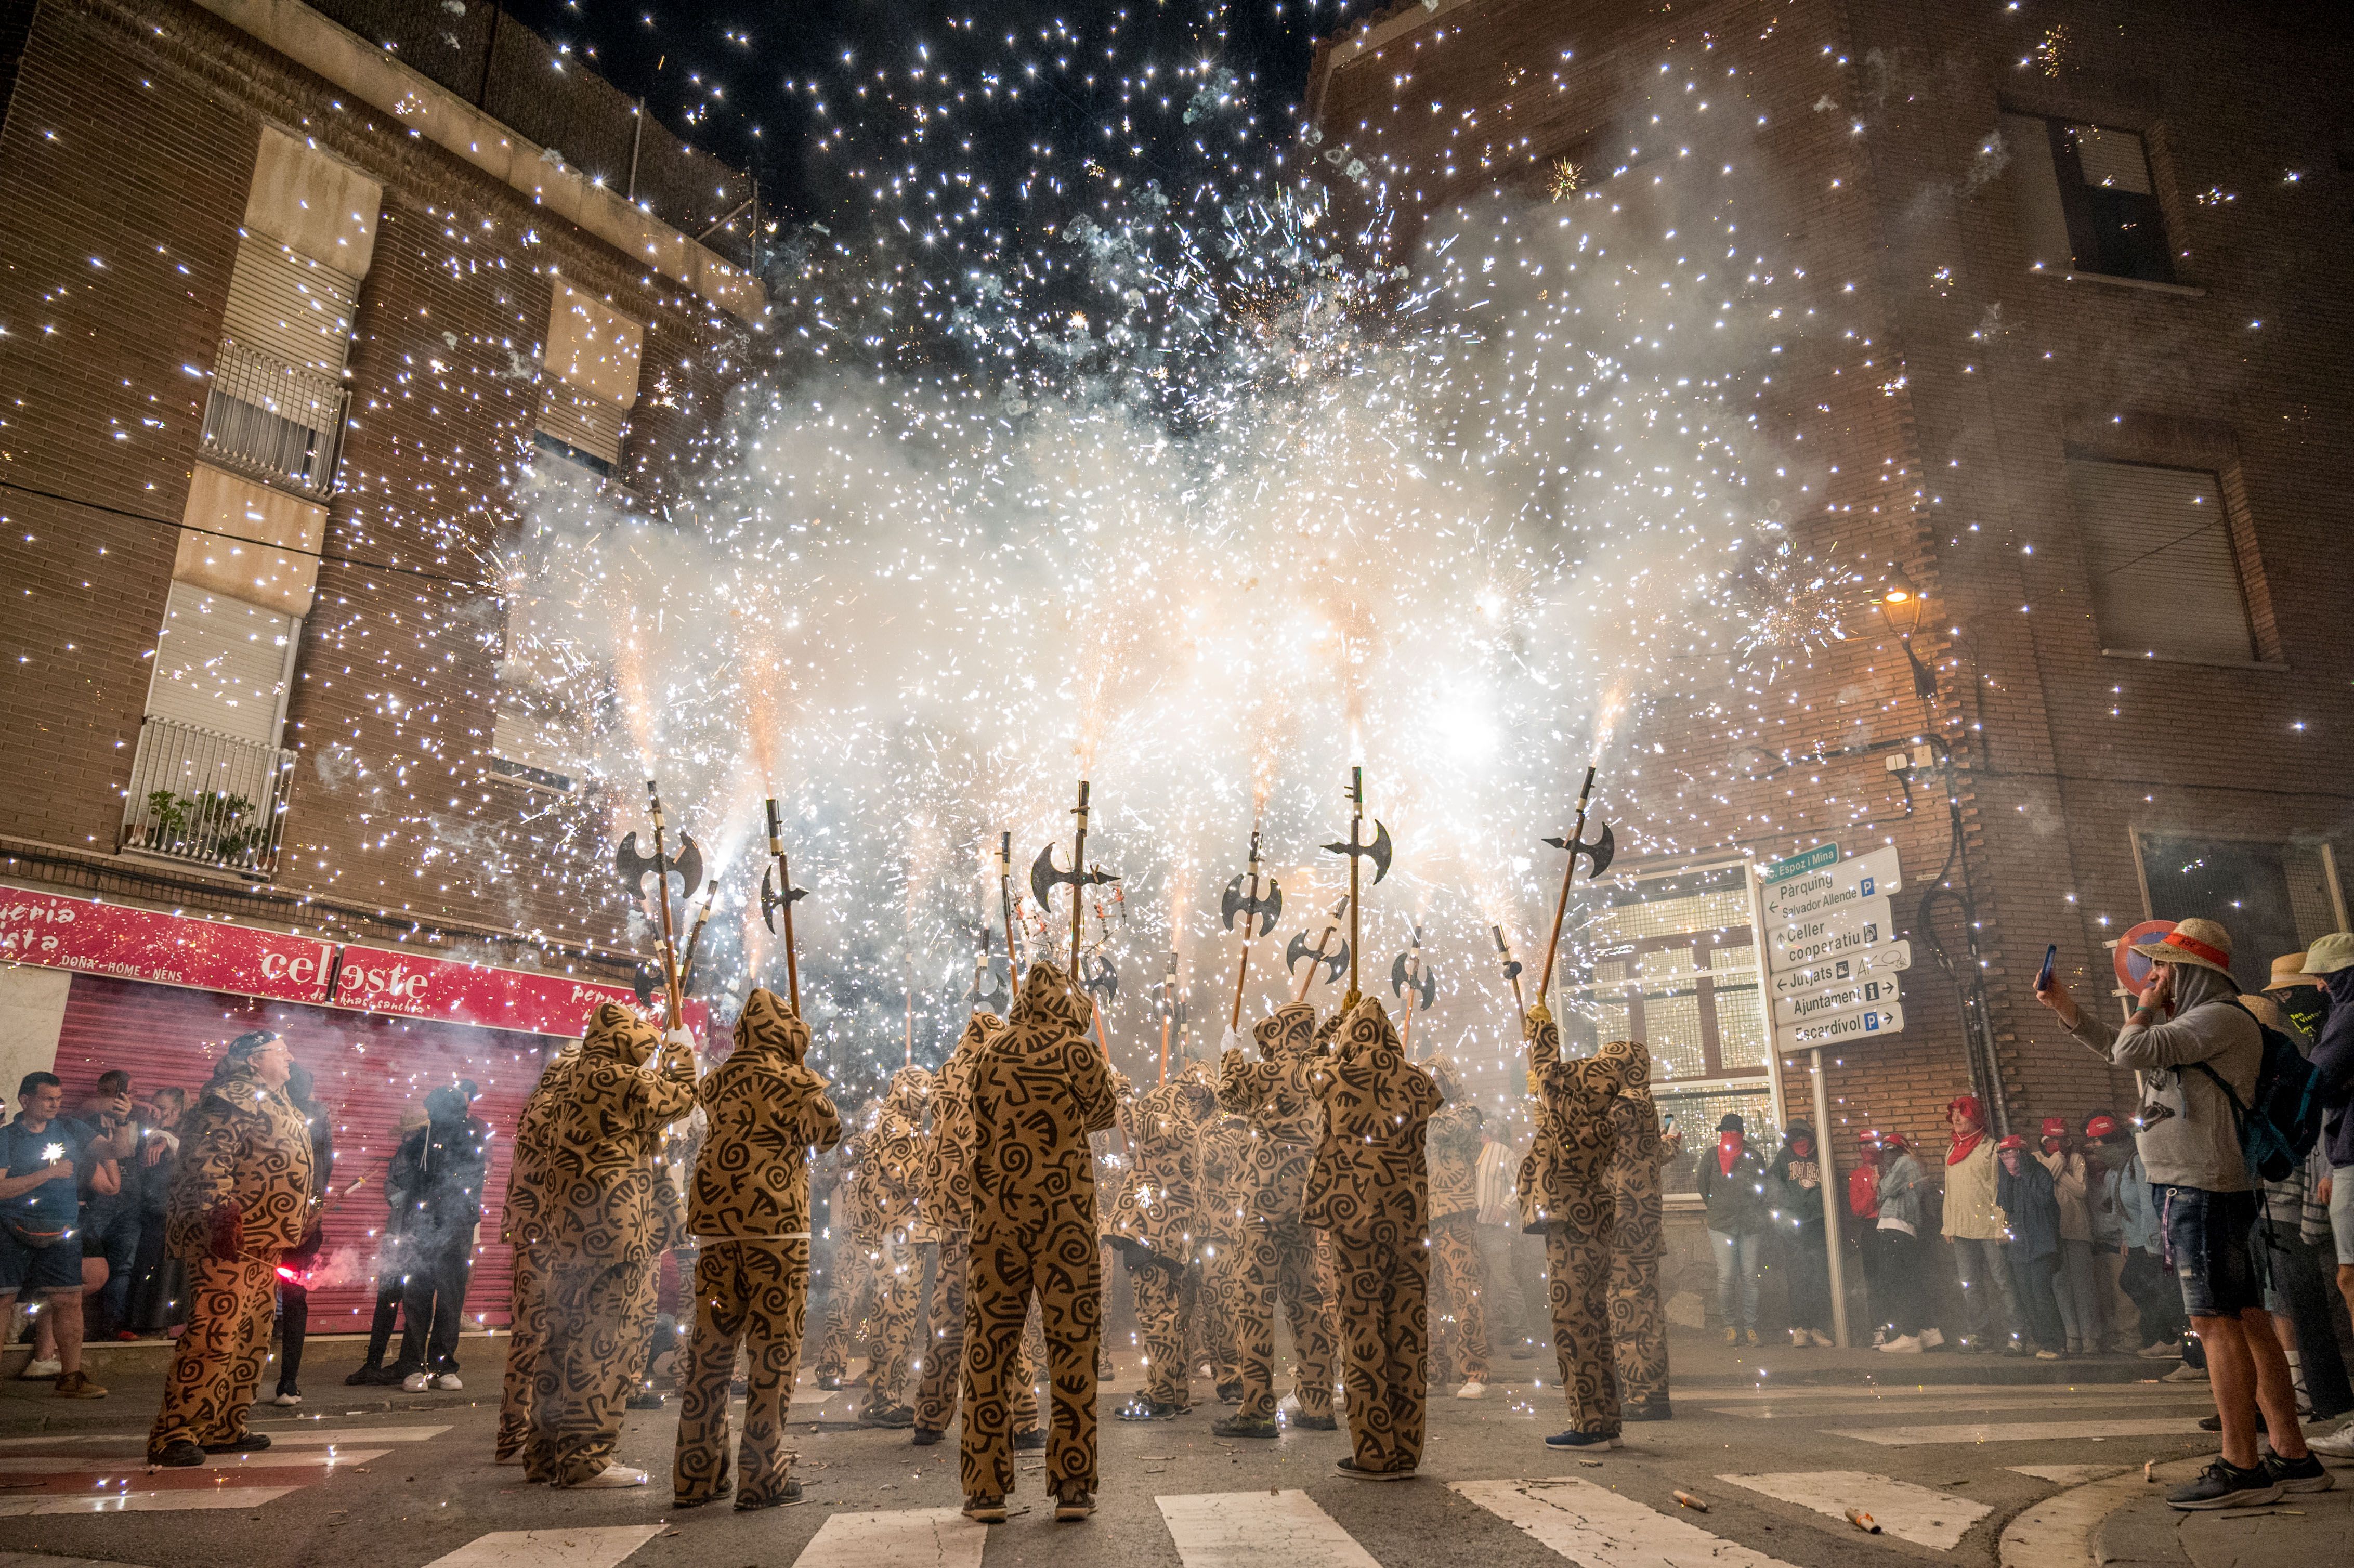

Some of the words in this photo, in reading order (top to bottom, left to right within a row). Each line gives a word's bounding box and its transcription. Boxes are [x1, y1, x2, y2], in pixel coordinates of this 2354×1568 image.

[1779, 860, 1806, 877] Espoz
[1807, 857, 1812, 866] i
[1812, 851, 1834, 864] Mina
[1780, 874, 1833, 900] Pàrquing
[1782, 899, 1821, 919] Salvador
[1823, 888, 1857, 907] Allende
[1864, 881, 1872, 895] P
[1787, 922, 1825, 942] Celler
[1789, 932, 1860, 962] cooperatiu
[107, 961, 141, 976] HOME
[152, 968, 183, 982] NENS
[1790, 967, 1833, 988] Jutjats
[310, 987, 325, 1001] de
[1794, 986, 1862, 1016] Ajuntament
[1795, 1015, 1861, 1042] Escardívol
[1867, 1015, 1876, 1029] P
